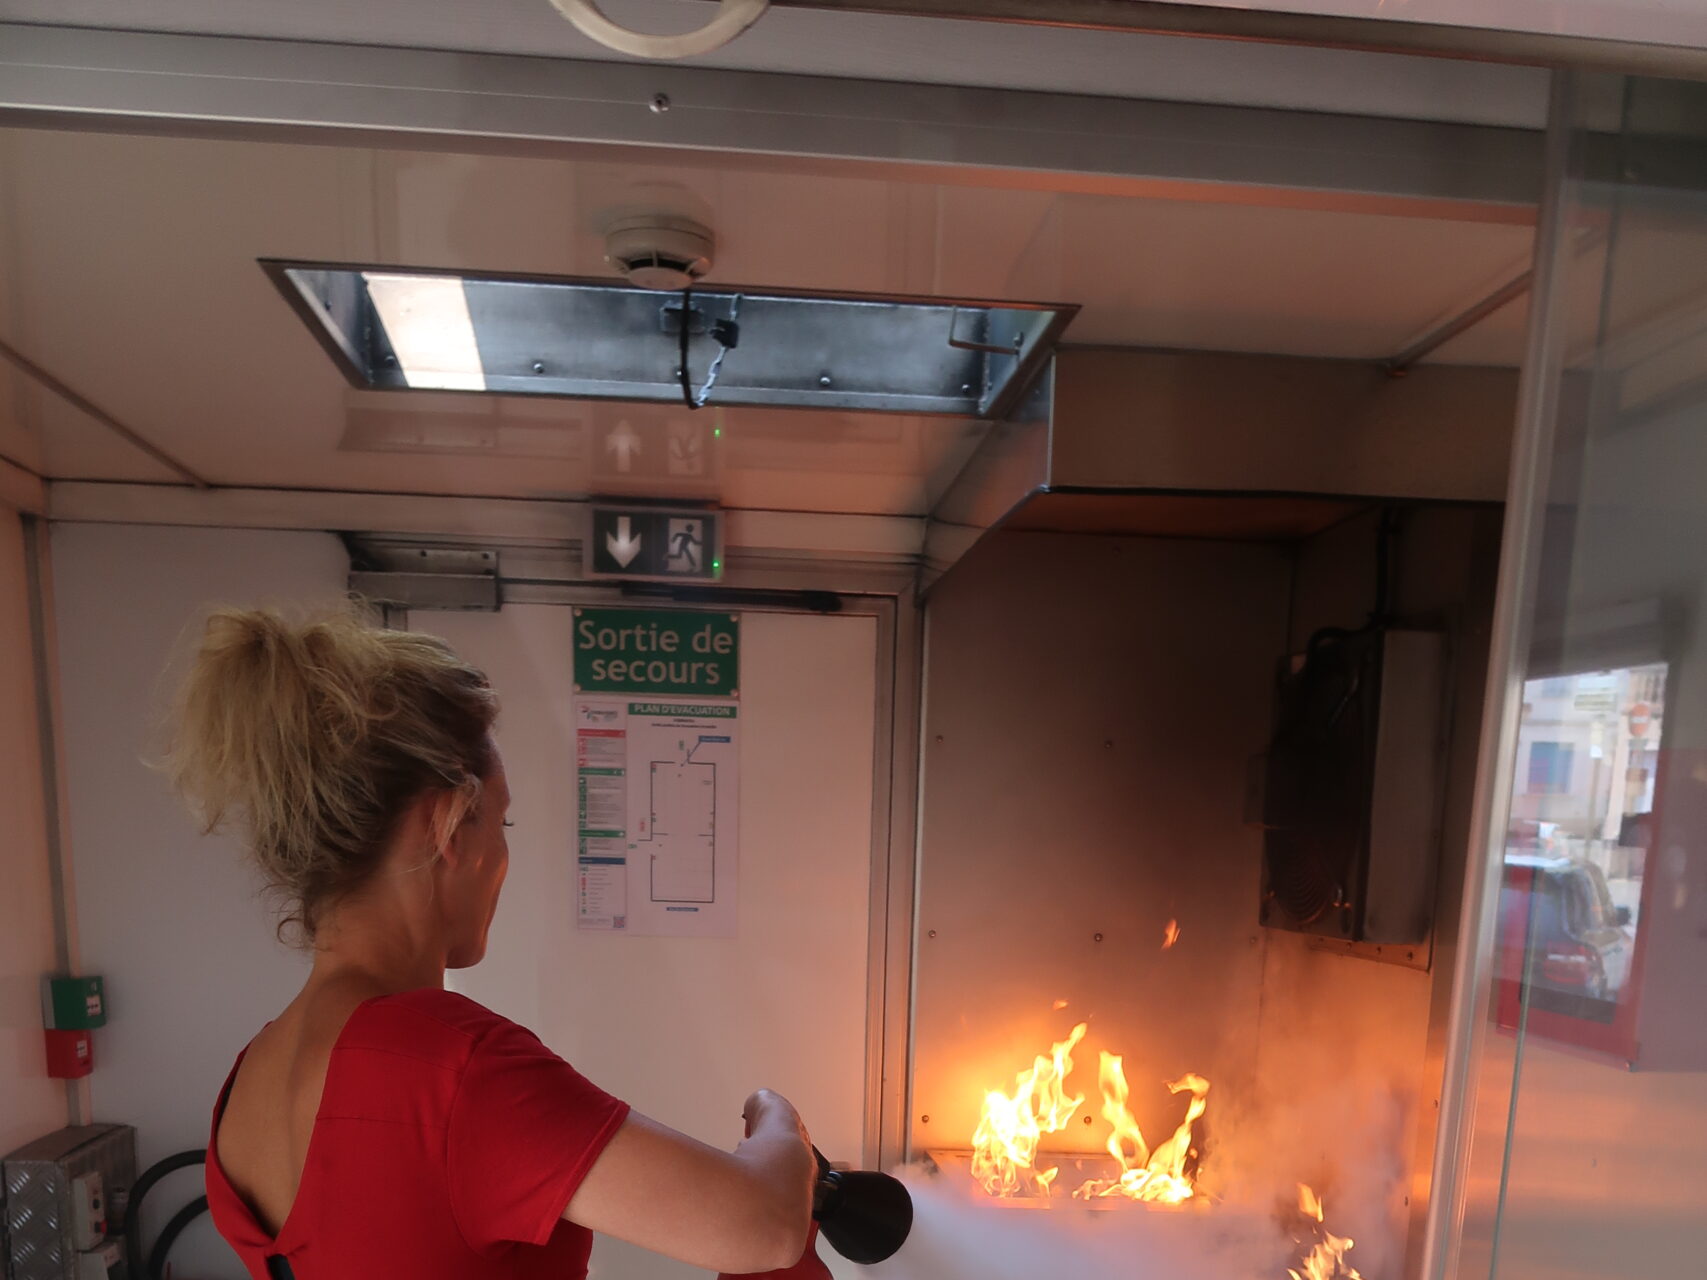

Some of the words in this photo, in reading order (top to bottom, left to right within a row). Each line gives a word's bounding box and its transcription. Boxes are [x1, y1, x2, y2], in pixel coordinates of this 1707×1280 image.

[579, 620, 680, 652] Sortie
[692, 624, 733, 654] de
[591, 658, 720, 684] secours
[634, 703, 660, 713] PLAN
